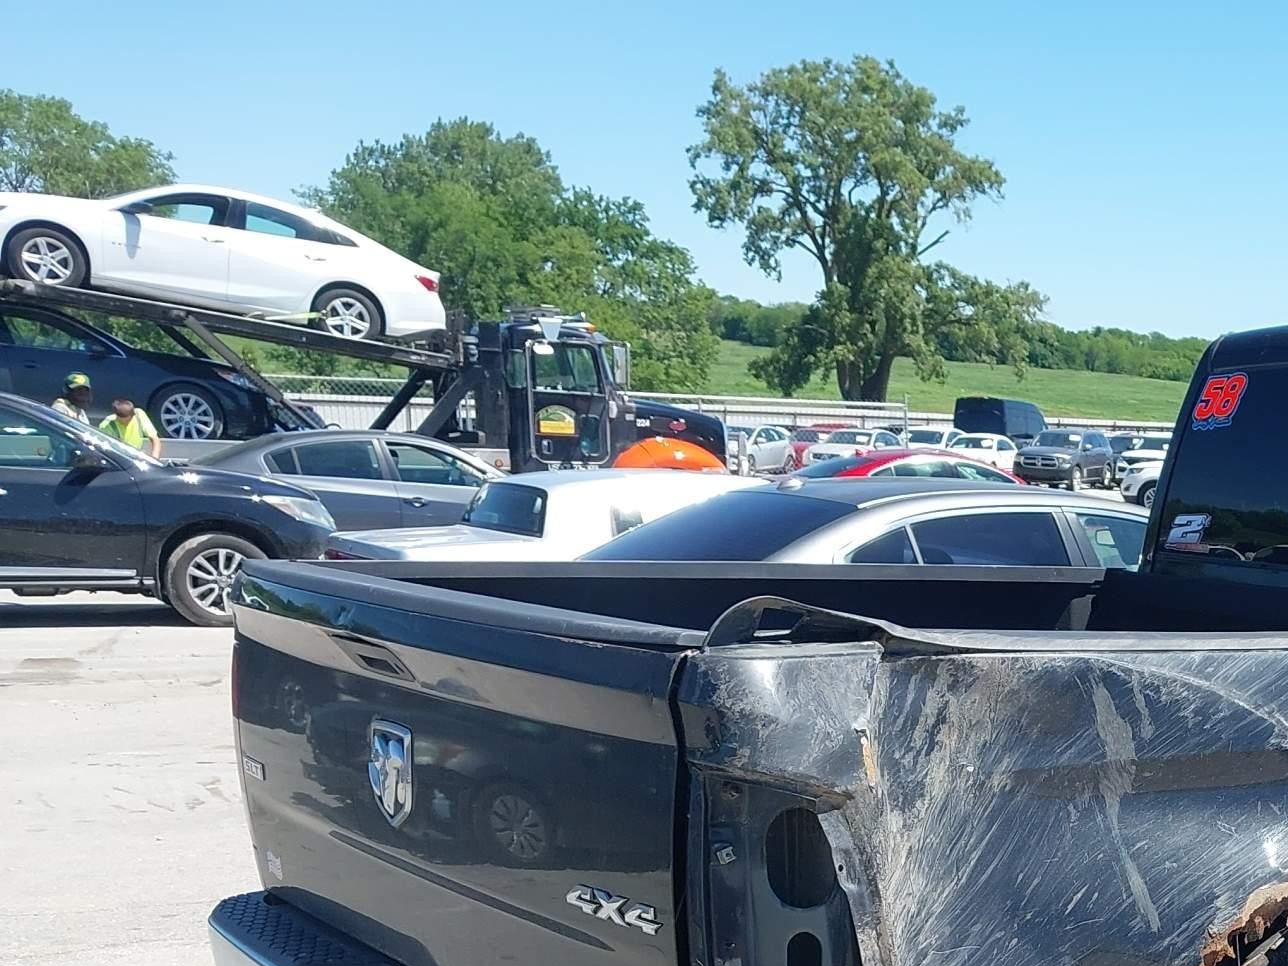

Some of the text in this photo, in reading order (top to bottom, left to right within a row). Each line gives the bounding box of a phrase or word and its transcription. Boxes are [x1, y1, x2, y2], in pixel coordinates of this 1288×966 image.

[1194, 373, 1247, 420] 58
[1167, 514, 1208, 544] 2
[245, 759, 260, 777] SLT
